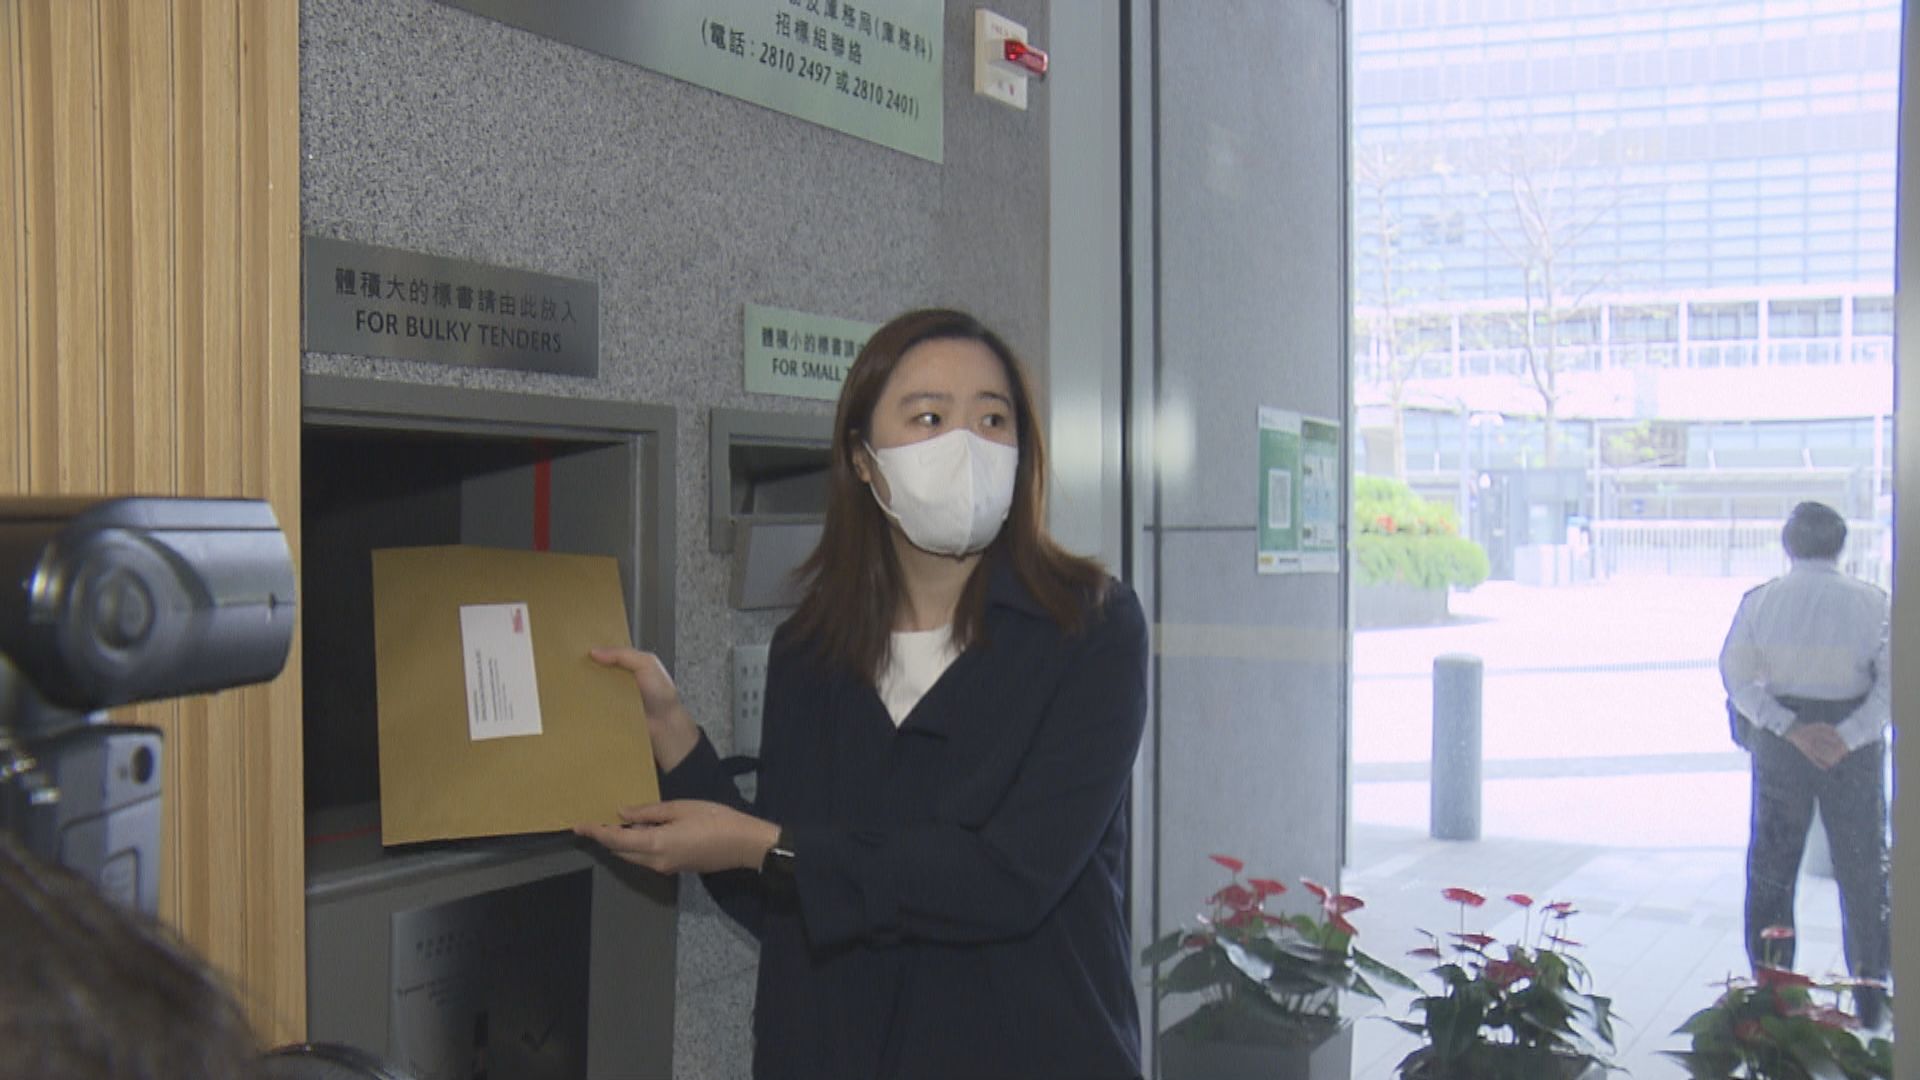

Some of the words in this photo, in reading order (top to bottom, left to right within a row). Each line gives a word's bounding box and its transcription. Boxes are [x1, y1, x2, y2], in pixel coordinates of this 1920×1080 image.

[760, 42, 794, 73] 2810
[798, 57, 831, 85] 2497
[835, 70, 849, 95] 或
[852, 76, 883, 105] 2810
[335, 267, 577, 324] 體積大的標書請由此放入
[356, 310, 398, 336] FOR
[406, 316, 472, 343] BULKY
[478, 324, 562, 354] TENDERS
[772, 358, 798, 378] FOR
[801, 361, 842, 382] SMALL
